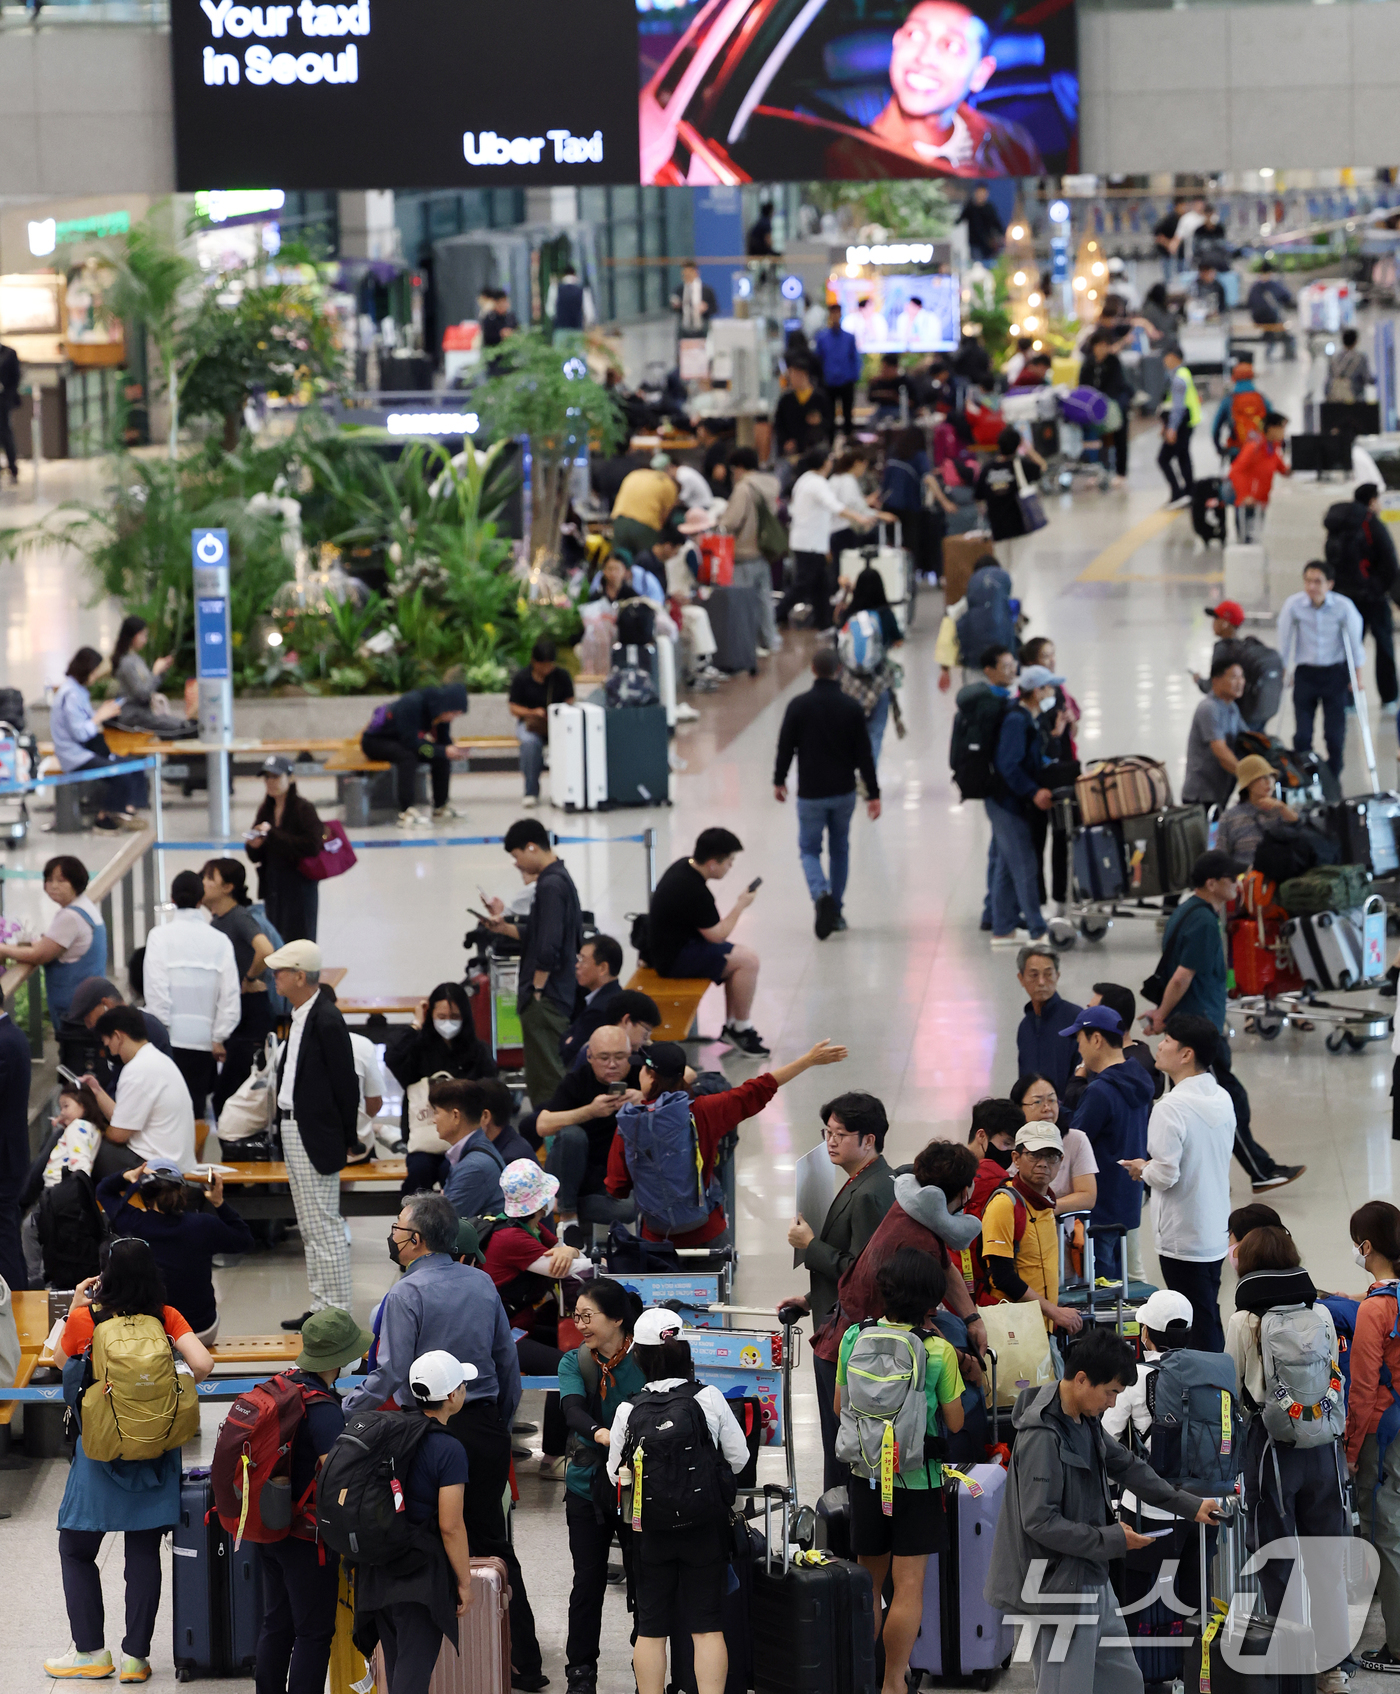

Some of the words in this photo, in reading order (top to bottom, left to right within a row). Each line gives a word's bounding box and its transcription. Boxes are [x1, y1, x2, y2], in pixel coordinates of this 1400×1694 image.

[200, 0, 293, 38] Your
[297, 0, 370, 36] taxi
[202, 46, 240, 85] in
[244, 43, 358, 85] Seoul
[463, 131, 546, 165] Uber
[546, 129, 603, 163] Taxi
[1362, 1660, 1385, 1671] crocs
